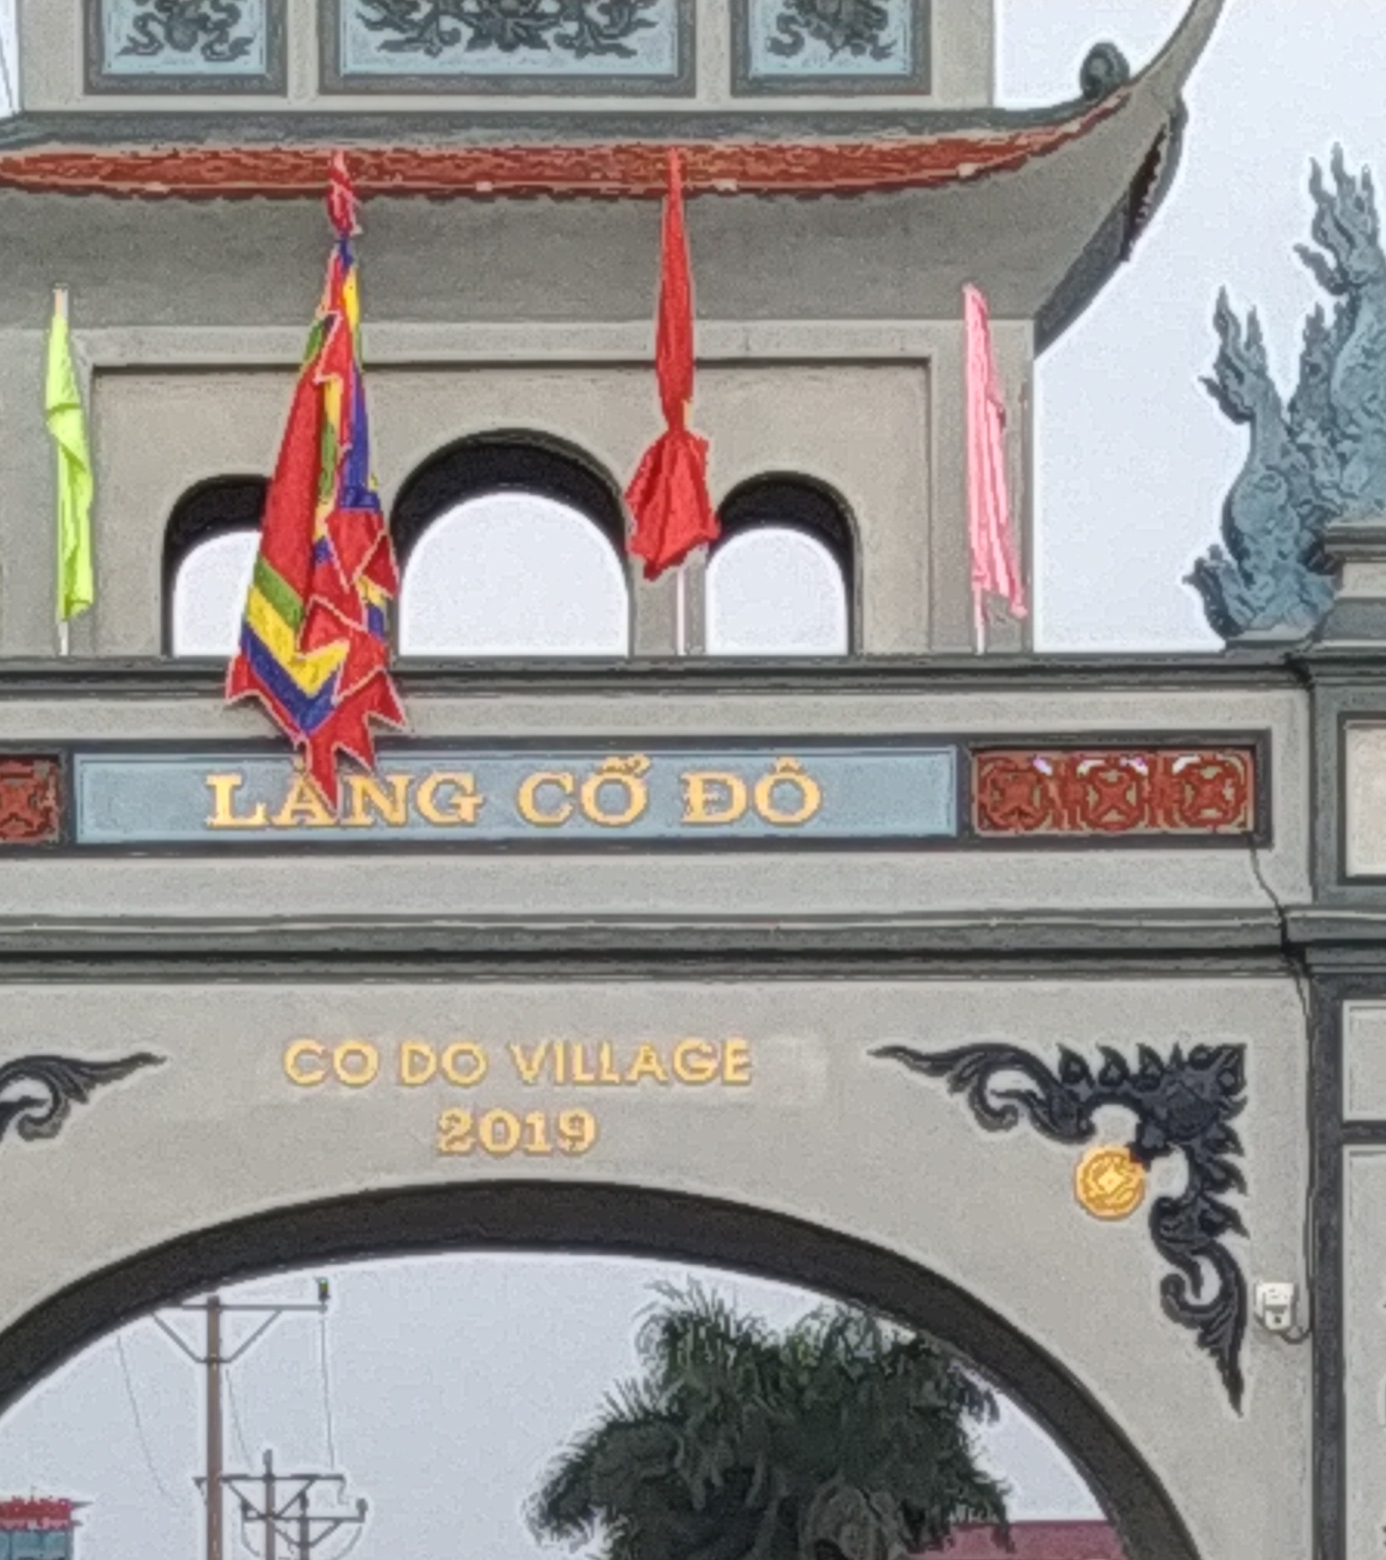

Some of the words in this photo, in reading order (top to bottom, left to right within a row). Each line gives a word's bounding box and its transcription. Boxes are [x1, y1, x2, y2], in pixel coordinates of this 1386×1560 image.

[514, 753, 653, 828] CỔ
[680, 756, 824, 828] ĐÔ
[282, 1037, 381, 1088] CO
[397, 1037, 489, 1087] DO
[510, 1037, 755, 1087] VILLAGE
[436, 1107, 599, 1157] 2019
